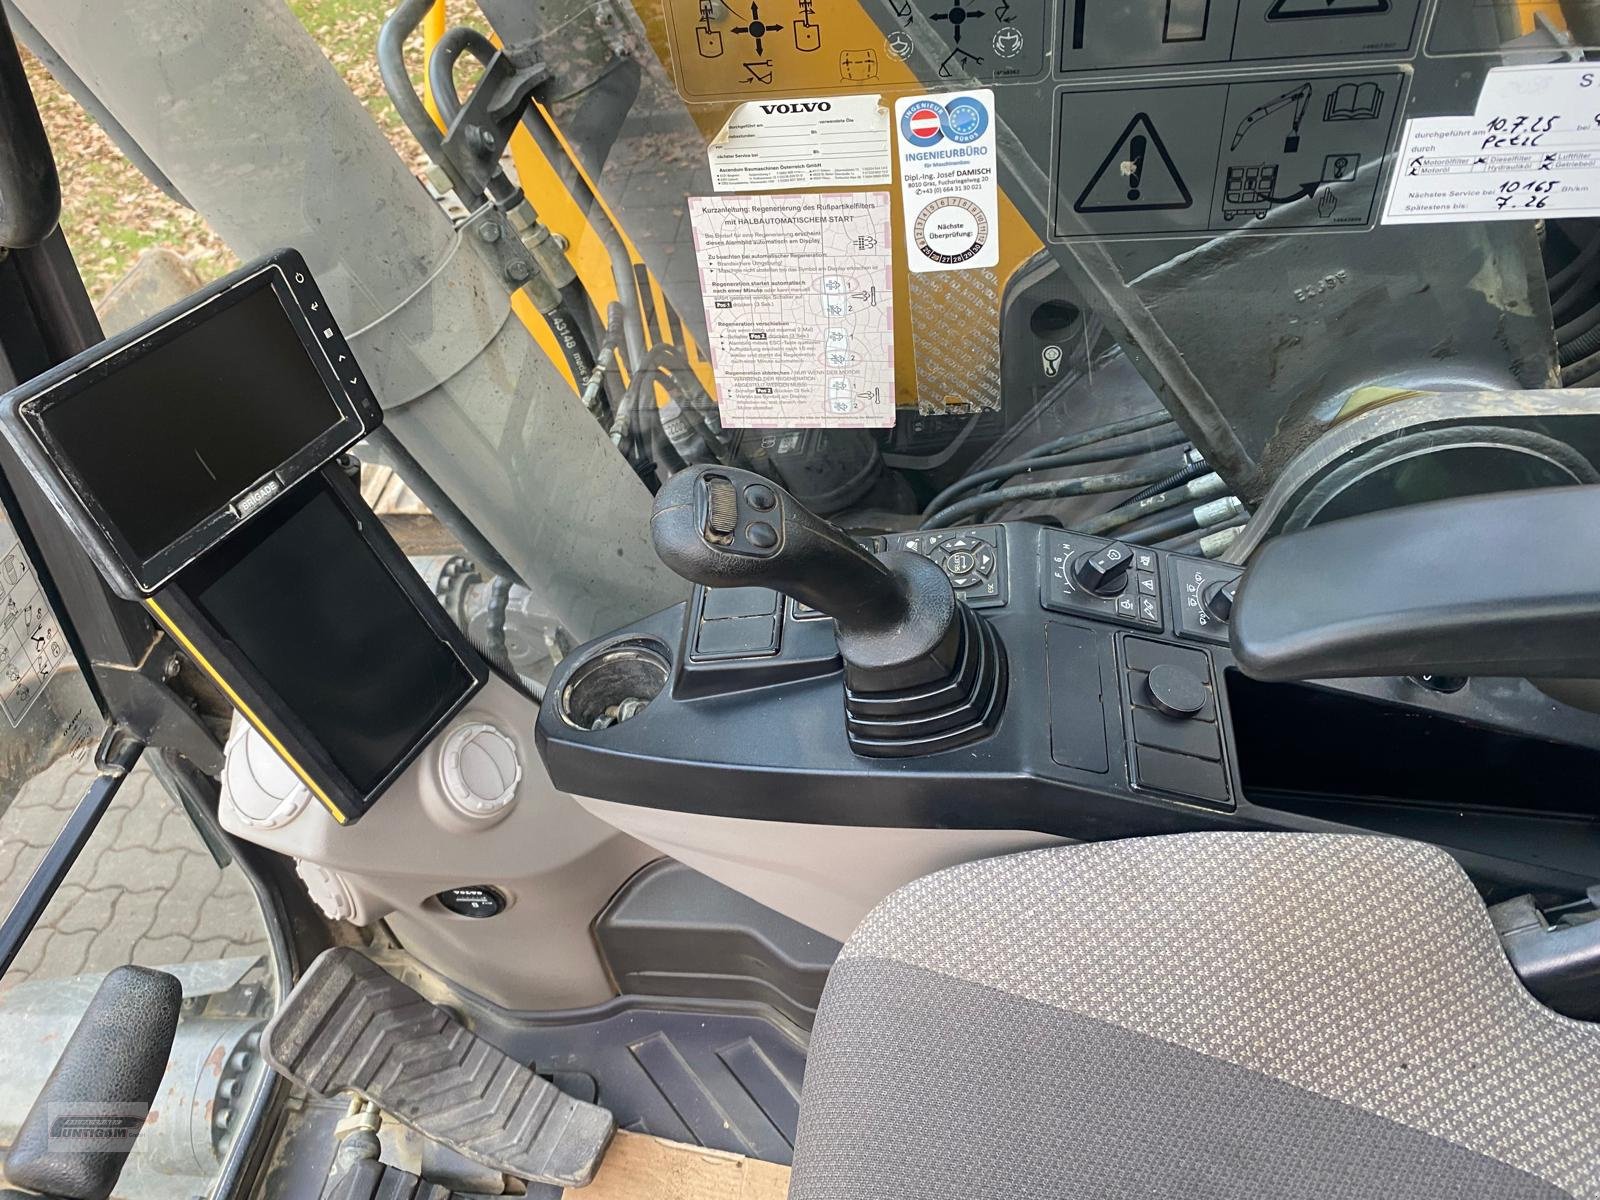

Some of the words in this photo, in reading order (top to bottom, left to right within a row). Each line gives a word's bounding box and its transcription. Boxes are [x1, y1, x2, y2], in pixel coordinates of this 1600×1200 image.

[760, 101, 831, 115] VOLVO
[904, 102, 944, 119] INGENIEUR
[954, 131, 979, 142] BÜROS
[1414, 130, 1471, 139] durchgeführt
[905, 146, 988, 162] INGENIEURBÜRO
[1411, 145, 1436, 153] durch
[1423, 157, 1469, 166] Motorölfilter
[1558, 152, 1592, 160] Luftfilter
[1487, 163, 1532, 172] Hydrauliköl
[1555, 160, 1596, 168] Getriebeöl
[904, 173, 936, 182] Dipl.-Ing.
[936, 171, 955, 179] Josef
[956, 168, 992, 177] DAMISCH
[1408, 191, 1447, 199] Nächstes
[752, 205, 802, 213] Regenerierung
[816, 202, 876, 212] Rußpartikelfilters
[1405, 204, 1451, 212] Spätestens
[738, 217, 828, 225] HALBAUTOMATISCHEM
[929, 230, 973, 240] Überprüfung:
[553, 317, 577, 349] 43148
[243, 481, 277, 510] BRIGADE
